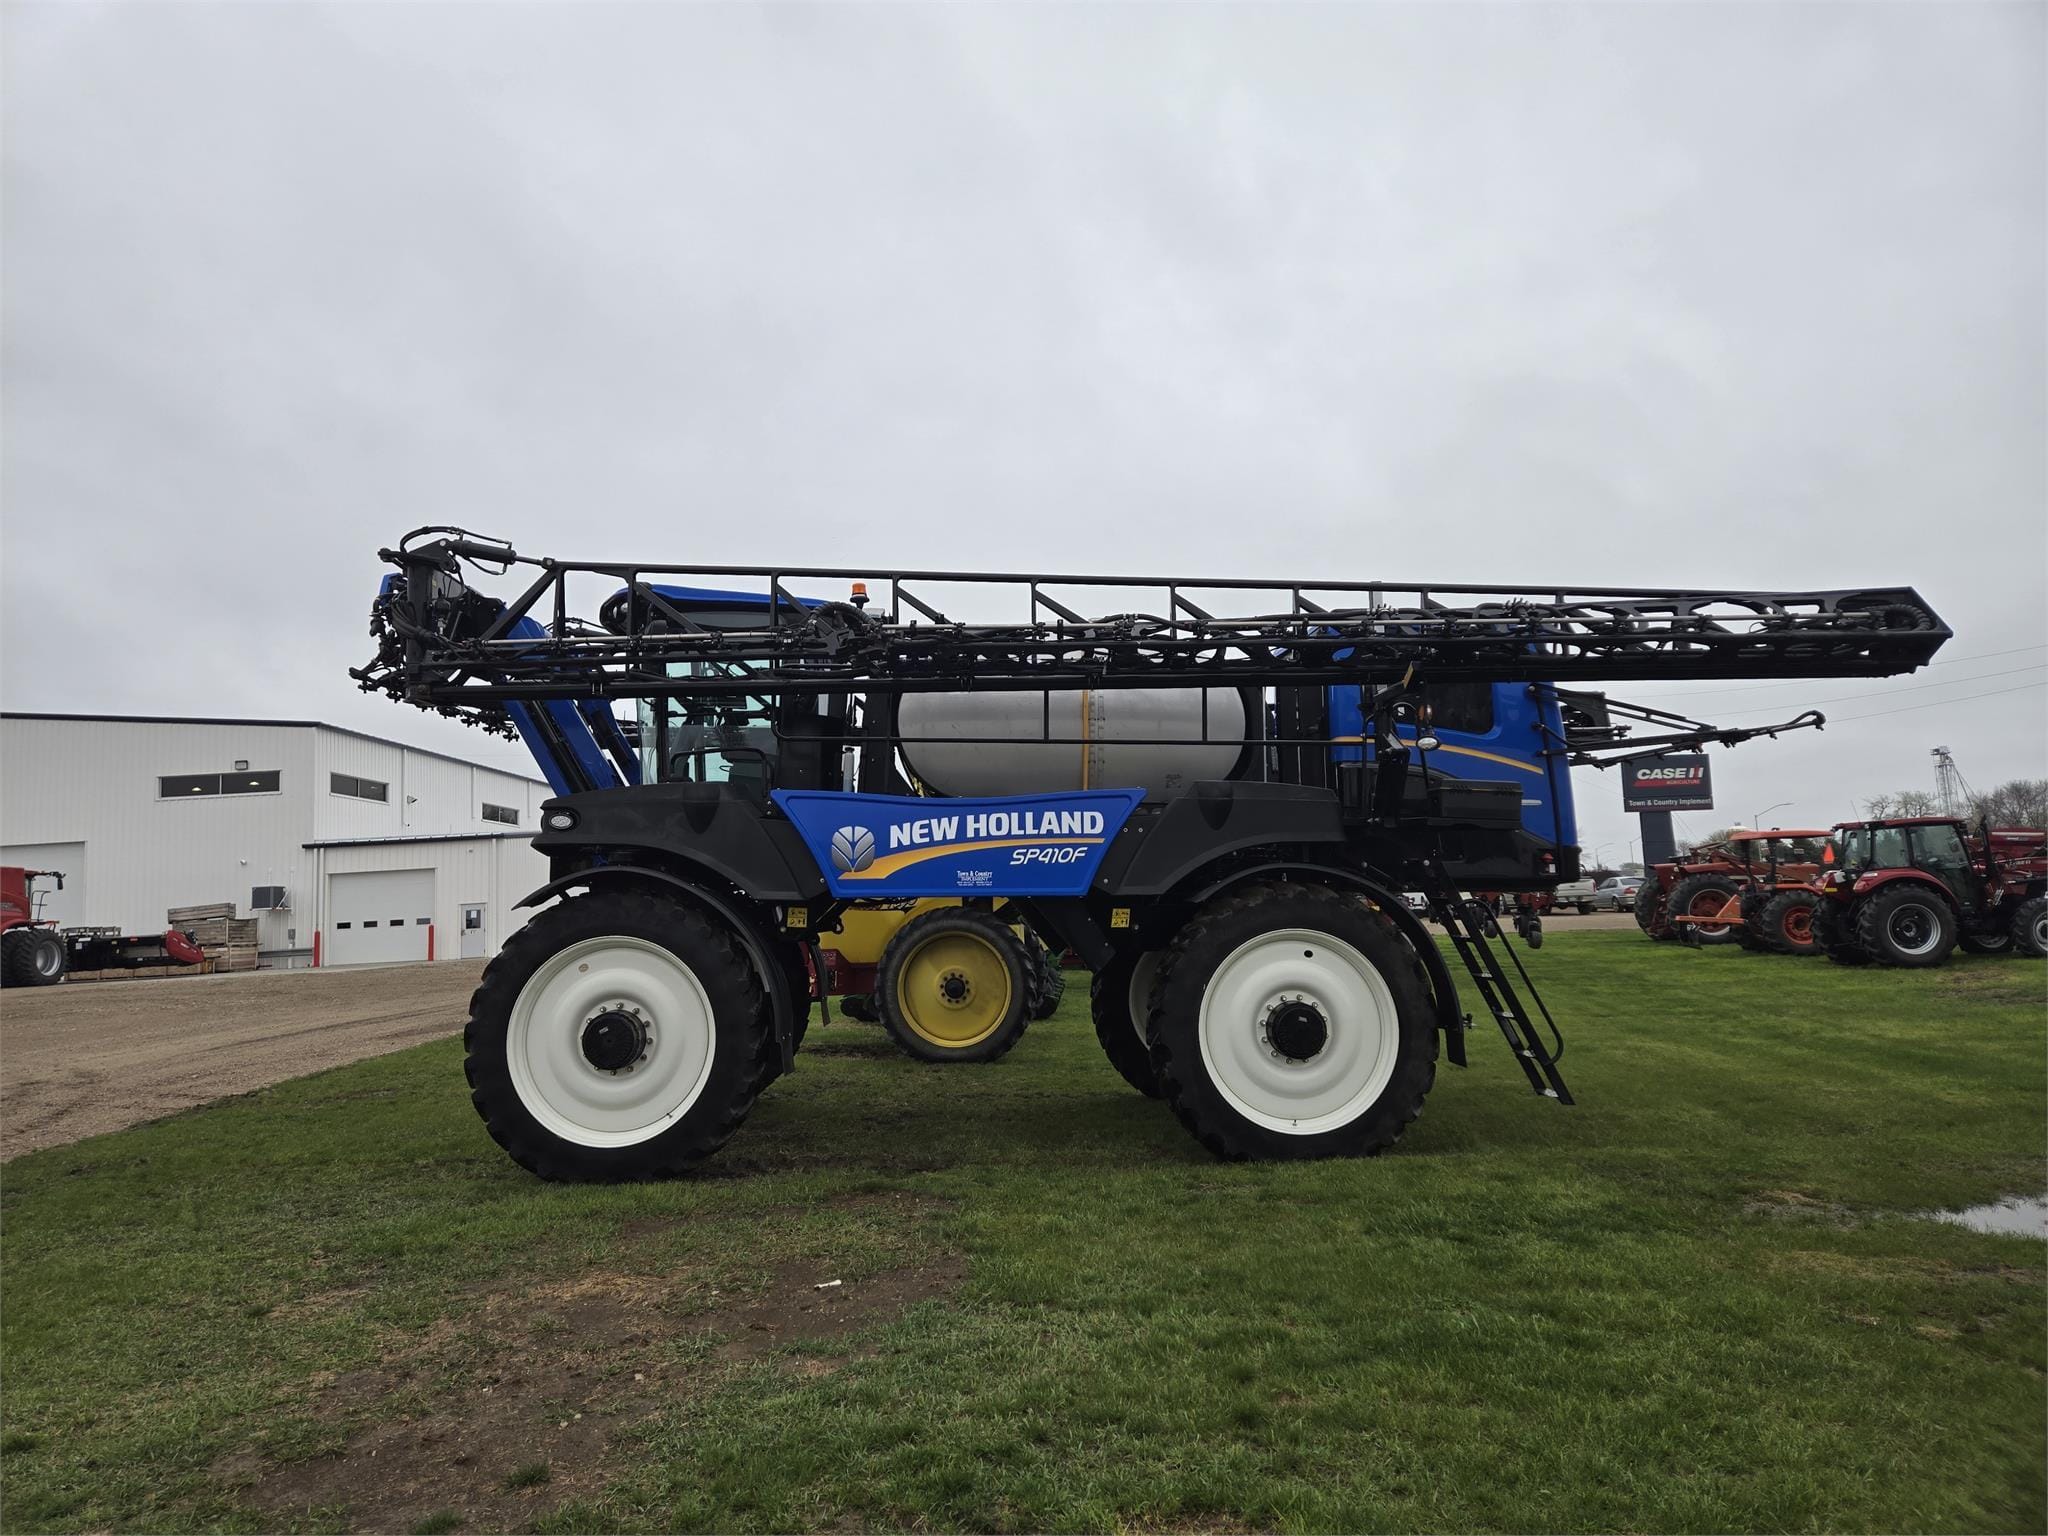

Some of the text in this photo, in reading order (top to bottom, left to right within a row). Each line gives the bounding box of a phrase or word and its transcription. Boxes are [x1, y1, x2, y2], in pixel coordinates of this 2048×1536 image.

[1637, 768, 1687, 779] CASE
[890, 811, 1105, 848] NEW HOLLAND
[1010, 847, 1088, 865] SP410F
